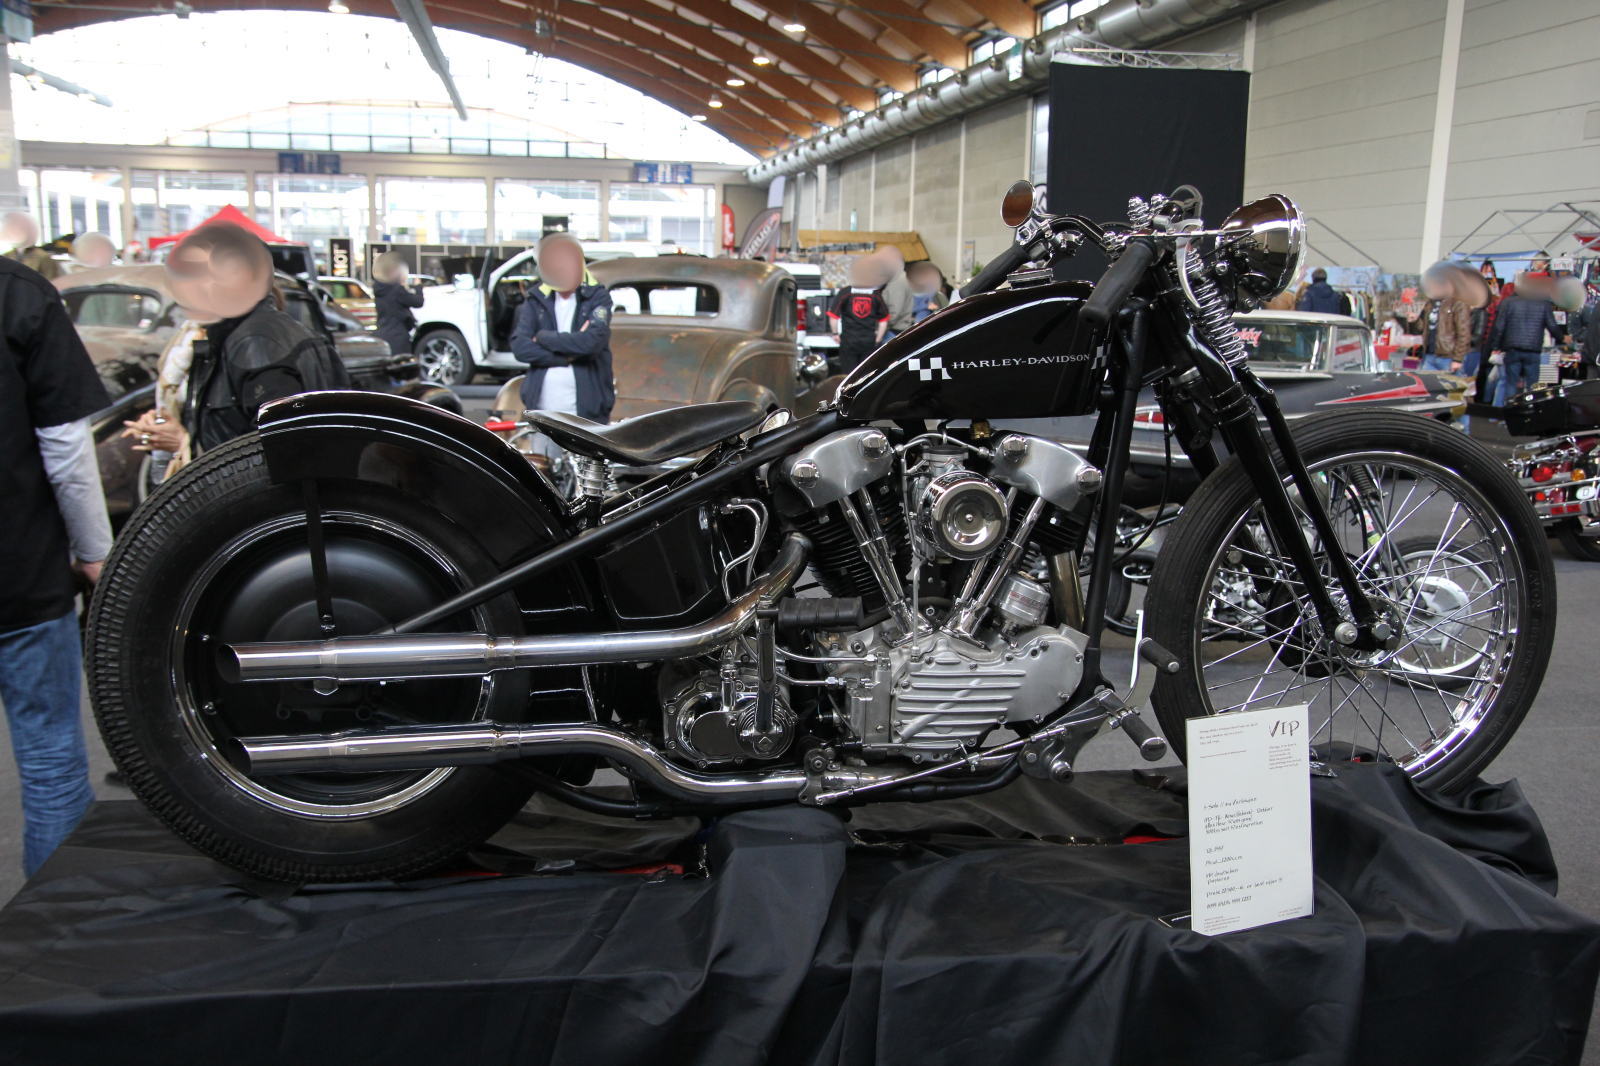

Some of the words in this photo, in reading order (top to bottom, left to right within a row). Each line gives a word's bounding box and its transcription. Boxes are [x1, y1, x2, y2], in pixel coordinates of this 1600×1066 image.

[951, 353, 1091, 370] HARLEY-DAVIDSON
[1582, 488, 1590, 497] D
[1269, 720, 1299, 738] VIP
